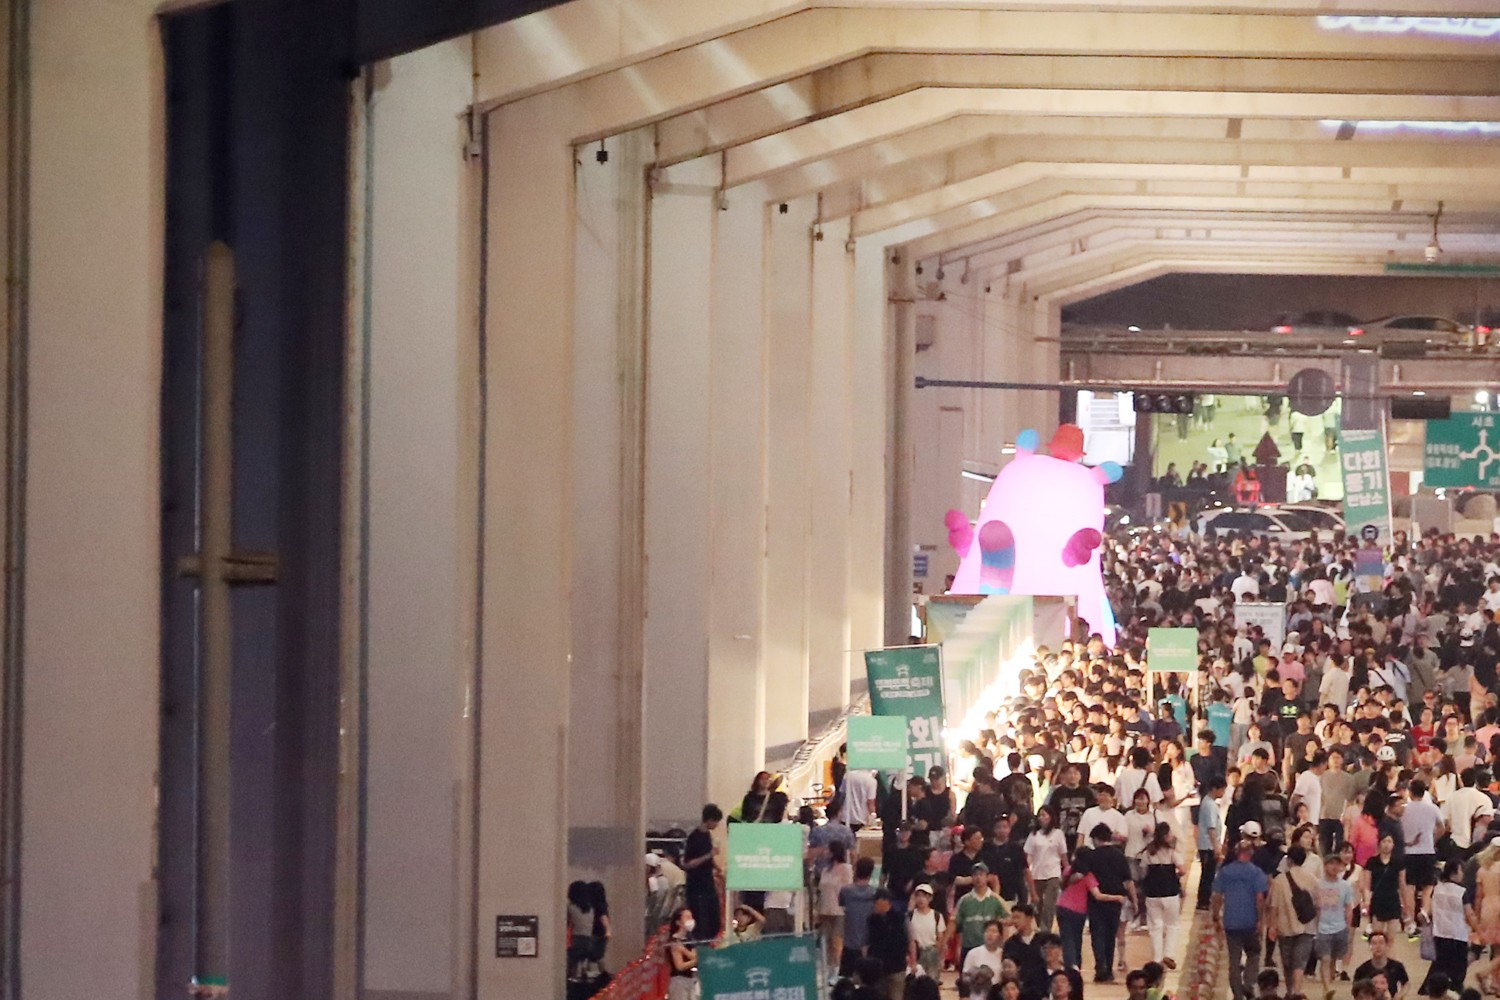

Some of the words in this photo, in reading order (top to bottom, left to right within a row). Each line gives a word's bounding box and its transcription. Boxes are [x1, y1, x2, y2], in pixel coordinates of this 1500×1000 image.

[1472, 415, 1494, 427] 서초
[1343, 450, 1381, 471] 다회
[906, 715, 940, 749] 회
